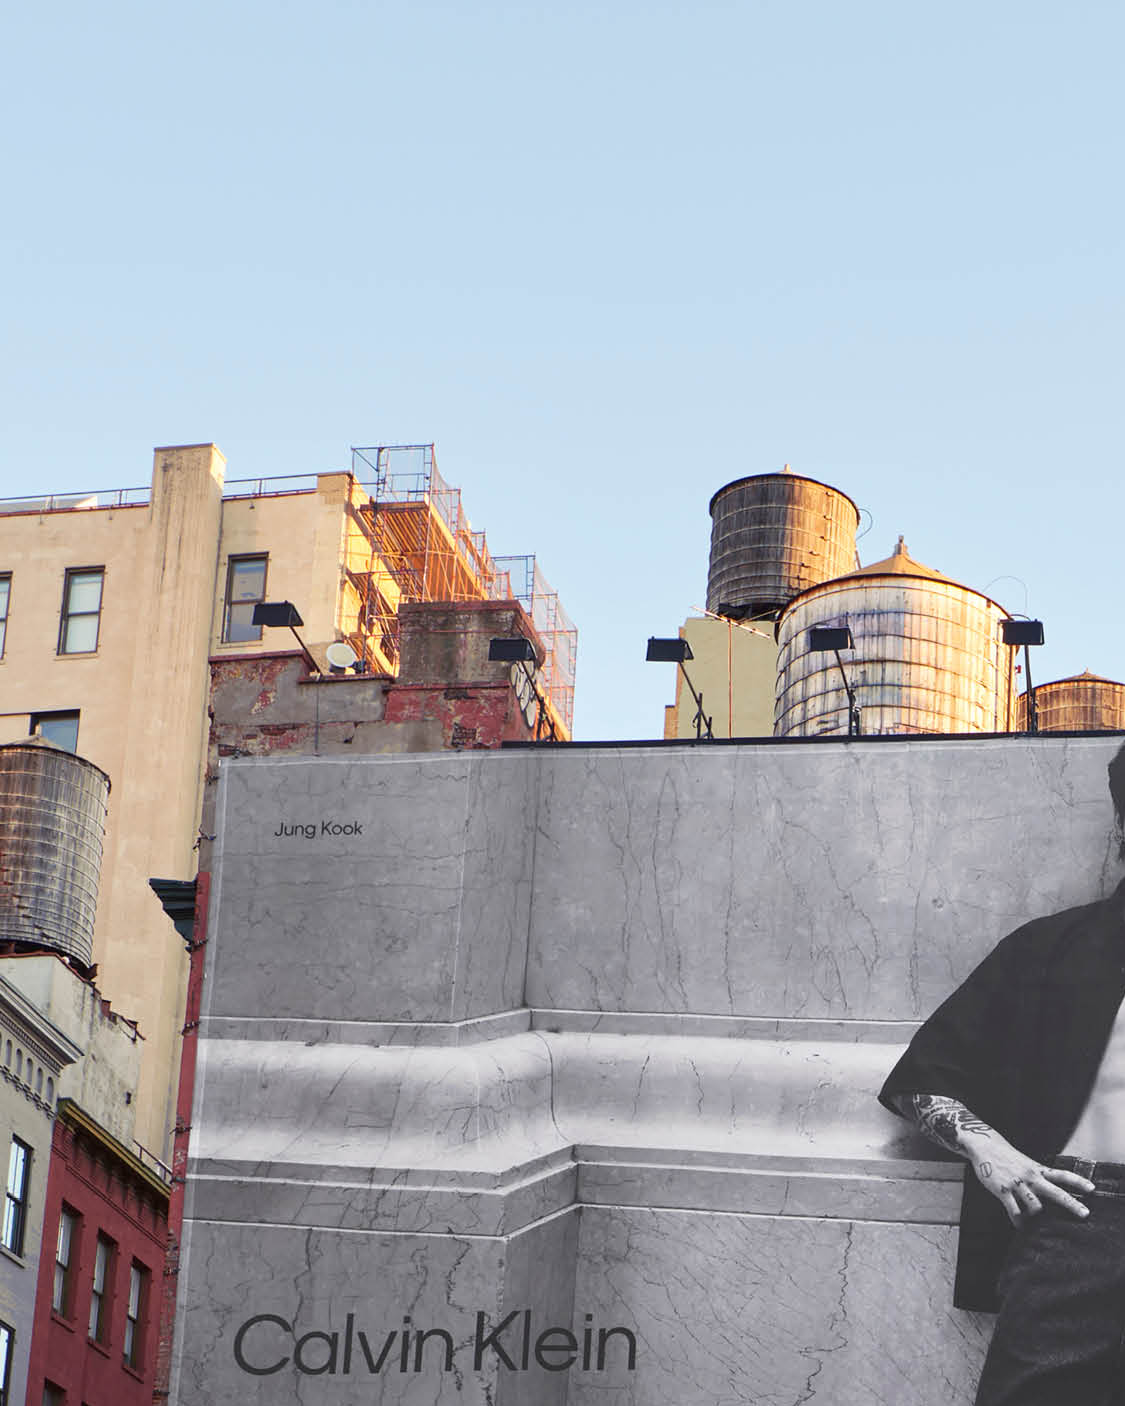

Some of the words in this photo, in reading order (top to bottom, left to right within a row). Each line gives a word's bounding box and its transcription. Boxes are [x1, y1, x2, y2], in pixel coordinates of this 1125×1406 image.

[274, 822, 316, 839] Jung
[321, 821, 363, 836] Kook
[233, 1313, 455, 1376] Calvin
[473, 1310, 637, 1372] Klein
